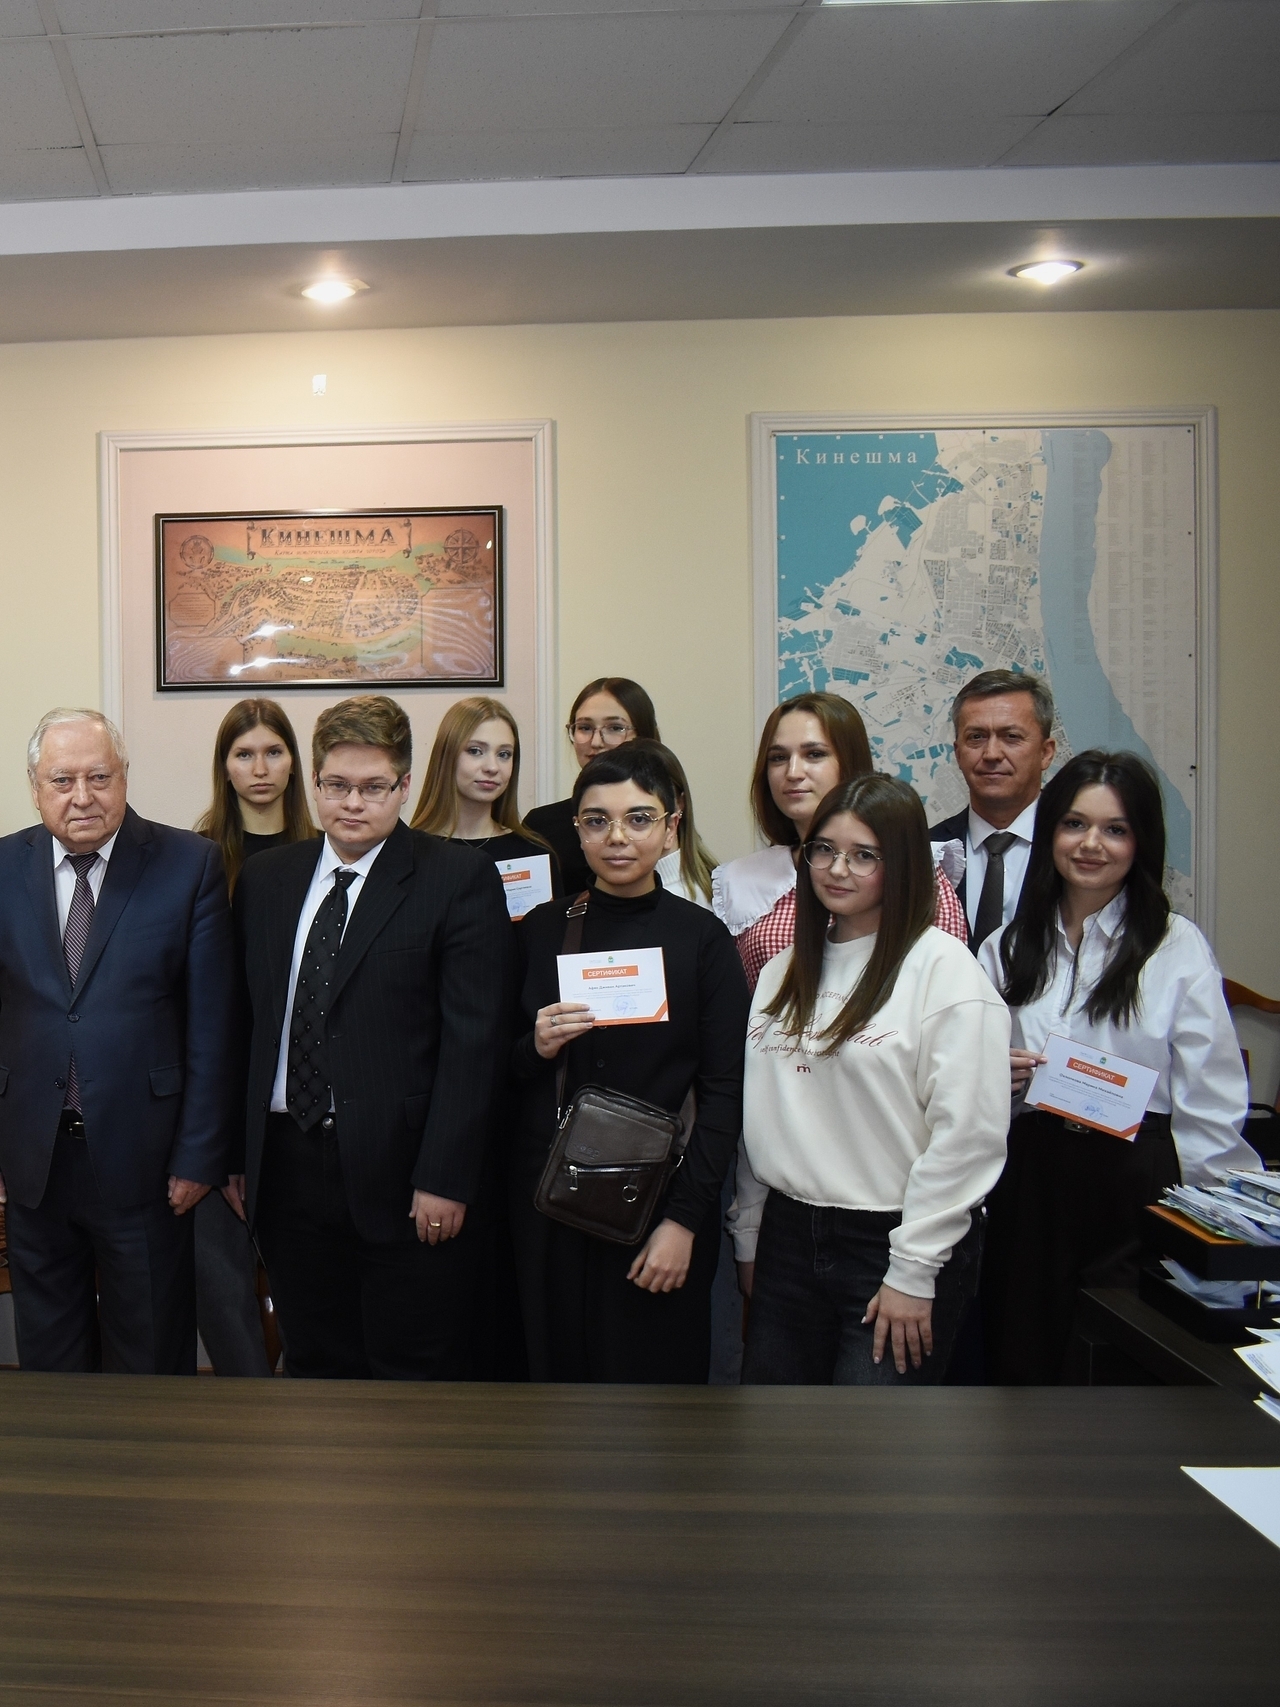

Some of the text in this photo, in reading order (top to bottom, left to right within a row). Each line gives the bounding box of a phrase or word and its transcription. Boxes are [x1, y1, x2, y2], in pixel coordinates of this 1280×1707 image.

[796, 448, 918, 465] Кинешма
[260, 527, 397, 546] КИНЕШМА
[587, 968, 628, 977] СЕРТИФИКАТ
[1072, 1061, 1116, 1081] СЕРТИФИКАТ
